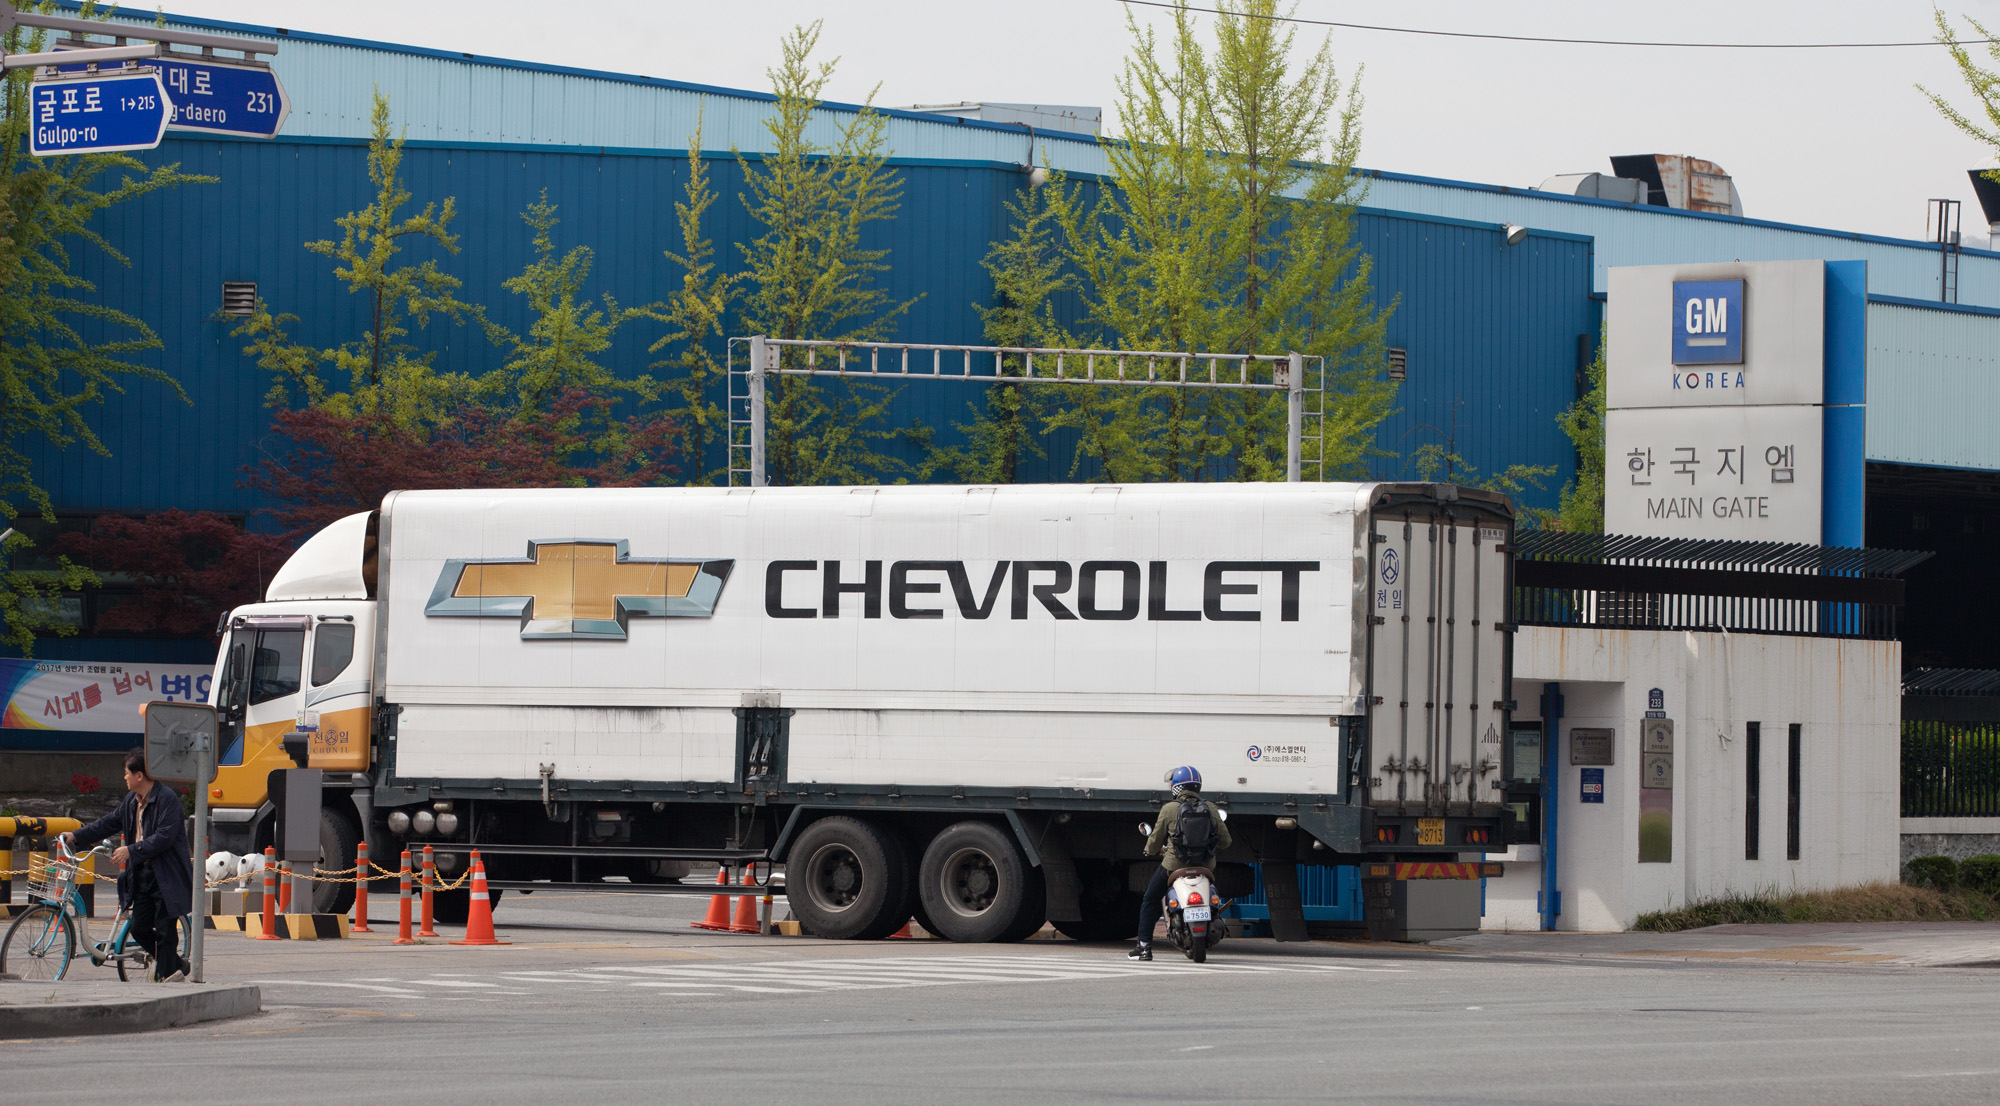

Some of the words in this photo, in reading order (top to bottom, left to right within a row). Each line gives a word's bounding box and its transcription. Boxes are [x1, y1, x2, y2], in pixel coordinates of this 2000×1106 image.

[38, 87, 103, 122] 굴포로
[138, 96, 155, 110] 215
[247, 91, 274, 114] 231
[38, 126, 98, 147] Gulpo-ro
[1685, 297, 1727, 334] GM
[1673, 372, 1745, 390] KOREA
[1626, 444, 1795, 486] 한국지엠
[1647, 497, 1703, 519] MAIN
[1712, 496, 1769, 519] GATE
[765, 560, 1320, 622] CHEVROLET
[36, 663, 62, 672] 2017년
[65, 665, 84, 673] 상반기
[110, 666, 122, 674] 교육
[44, 683, 102, 719] 시대를
[113, 671, 153, 695] 넘어
[1650, 698, 1662, 708] 233
[1191, 911, 1209, 920] 7530
